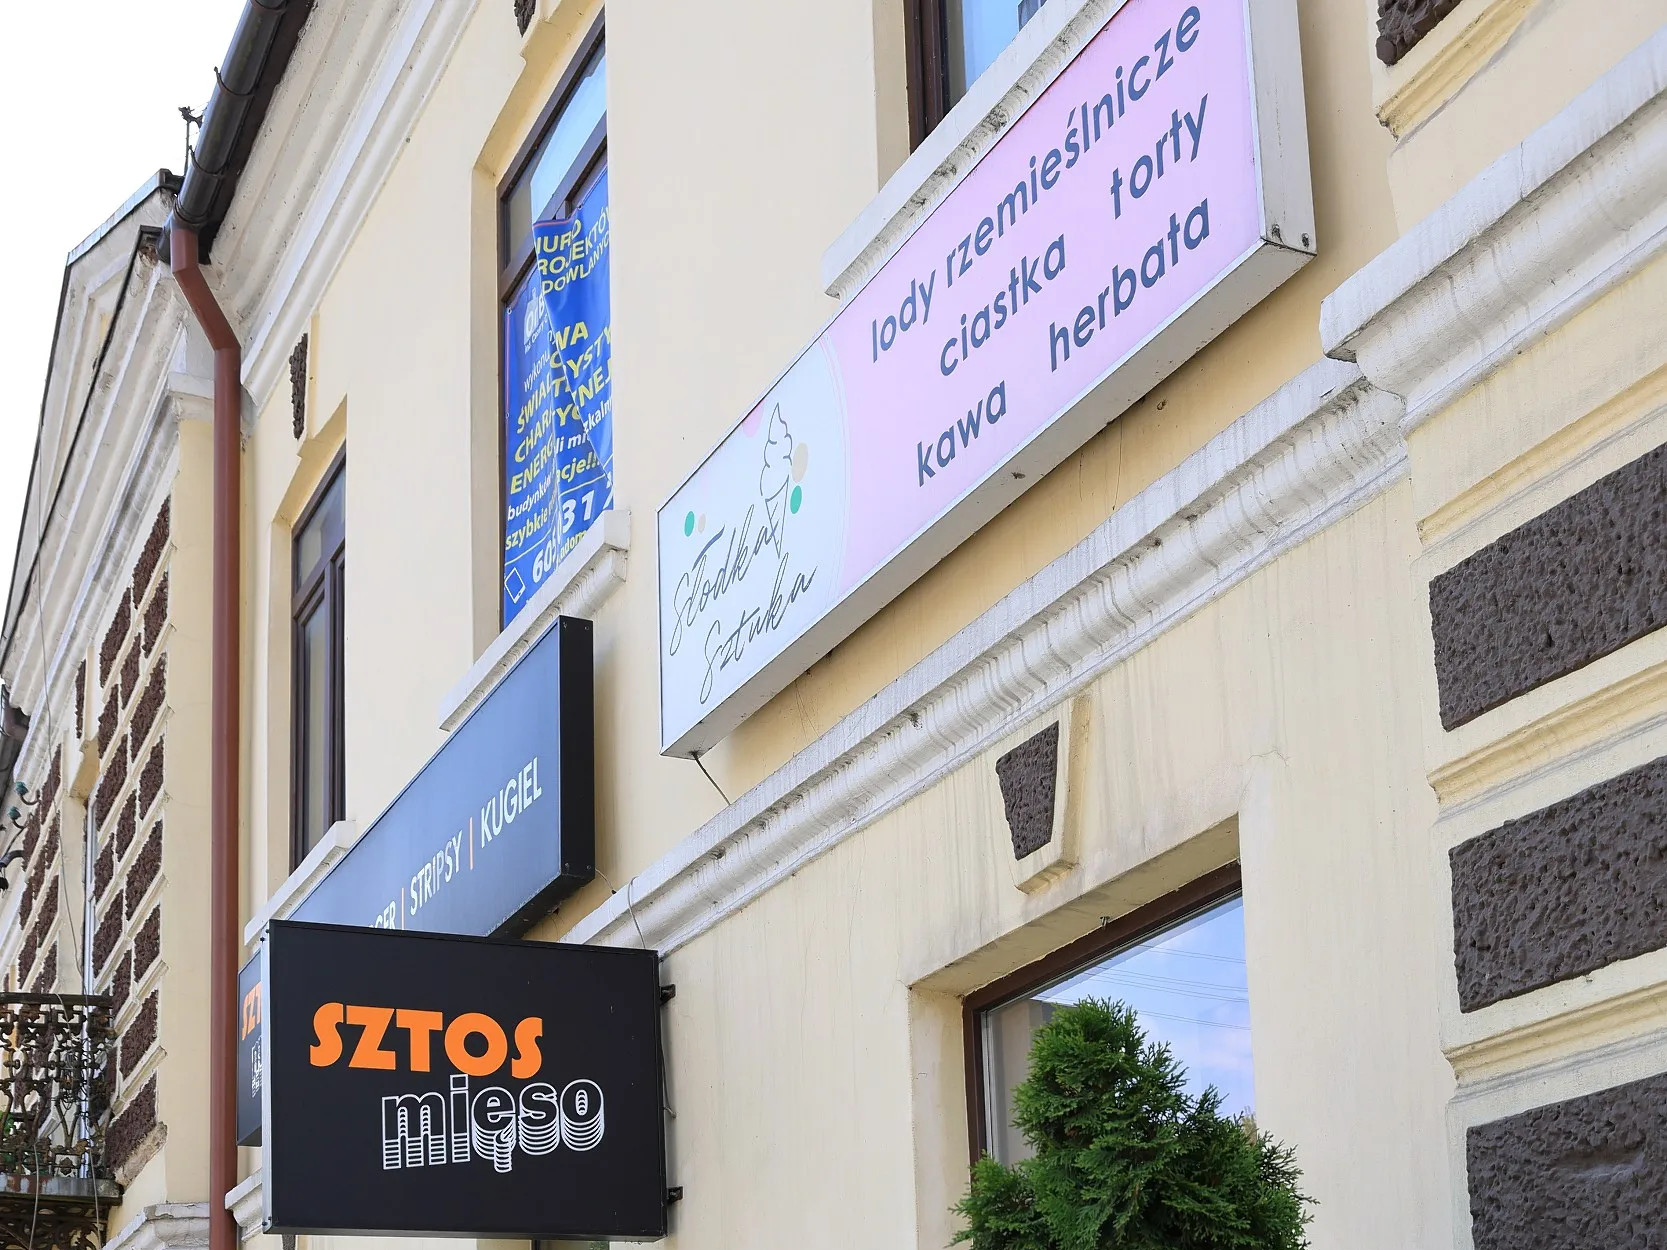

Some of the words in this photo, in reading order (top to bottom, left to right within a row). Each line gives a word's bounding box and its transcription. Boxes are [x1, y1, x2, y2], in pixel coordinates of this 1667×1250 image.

[871, 268, 936, 363] lody
[946, 5, 1201, 289] rzemieślnicze
[941, 234, 1066, 376] ciastka
[1110, 93, 1209, 219] torty
[917, 380, 1006, 487] kawa
[1049, 198, 1211, 371] herbata
[669, 503, 780, 656] Słodka
[700, 552, 818, 704] Sztuka
[410, 829, 463, 916] STRIPSY
[481, 756, 542, 849] KUGIEL
[310, 1001, 544, 1080] SZTOS
[381, 1074, 606, 1173] mięso
